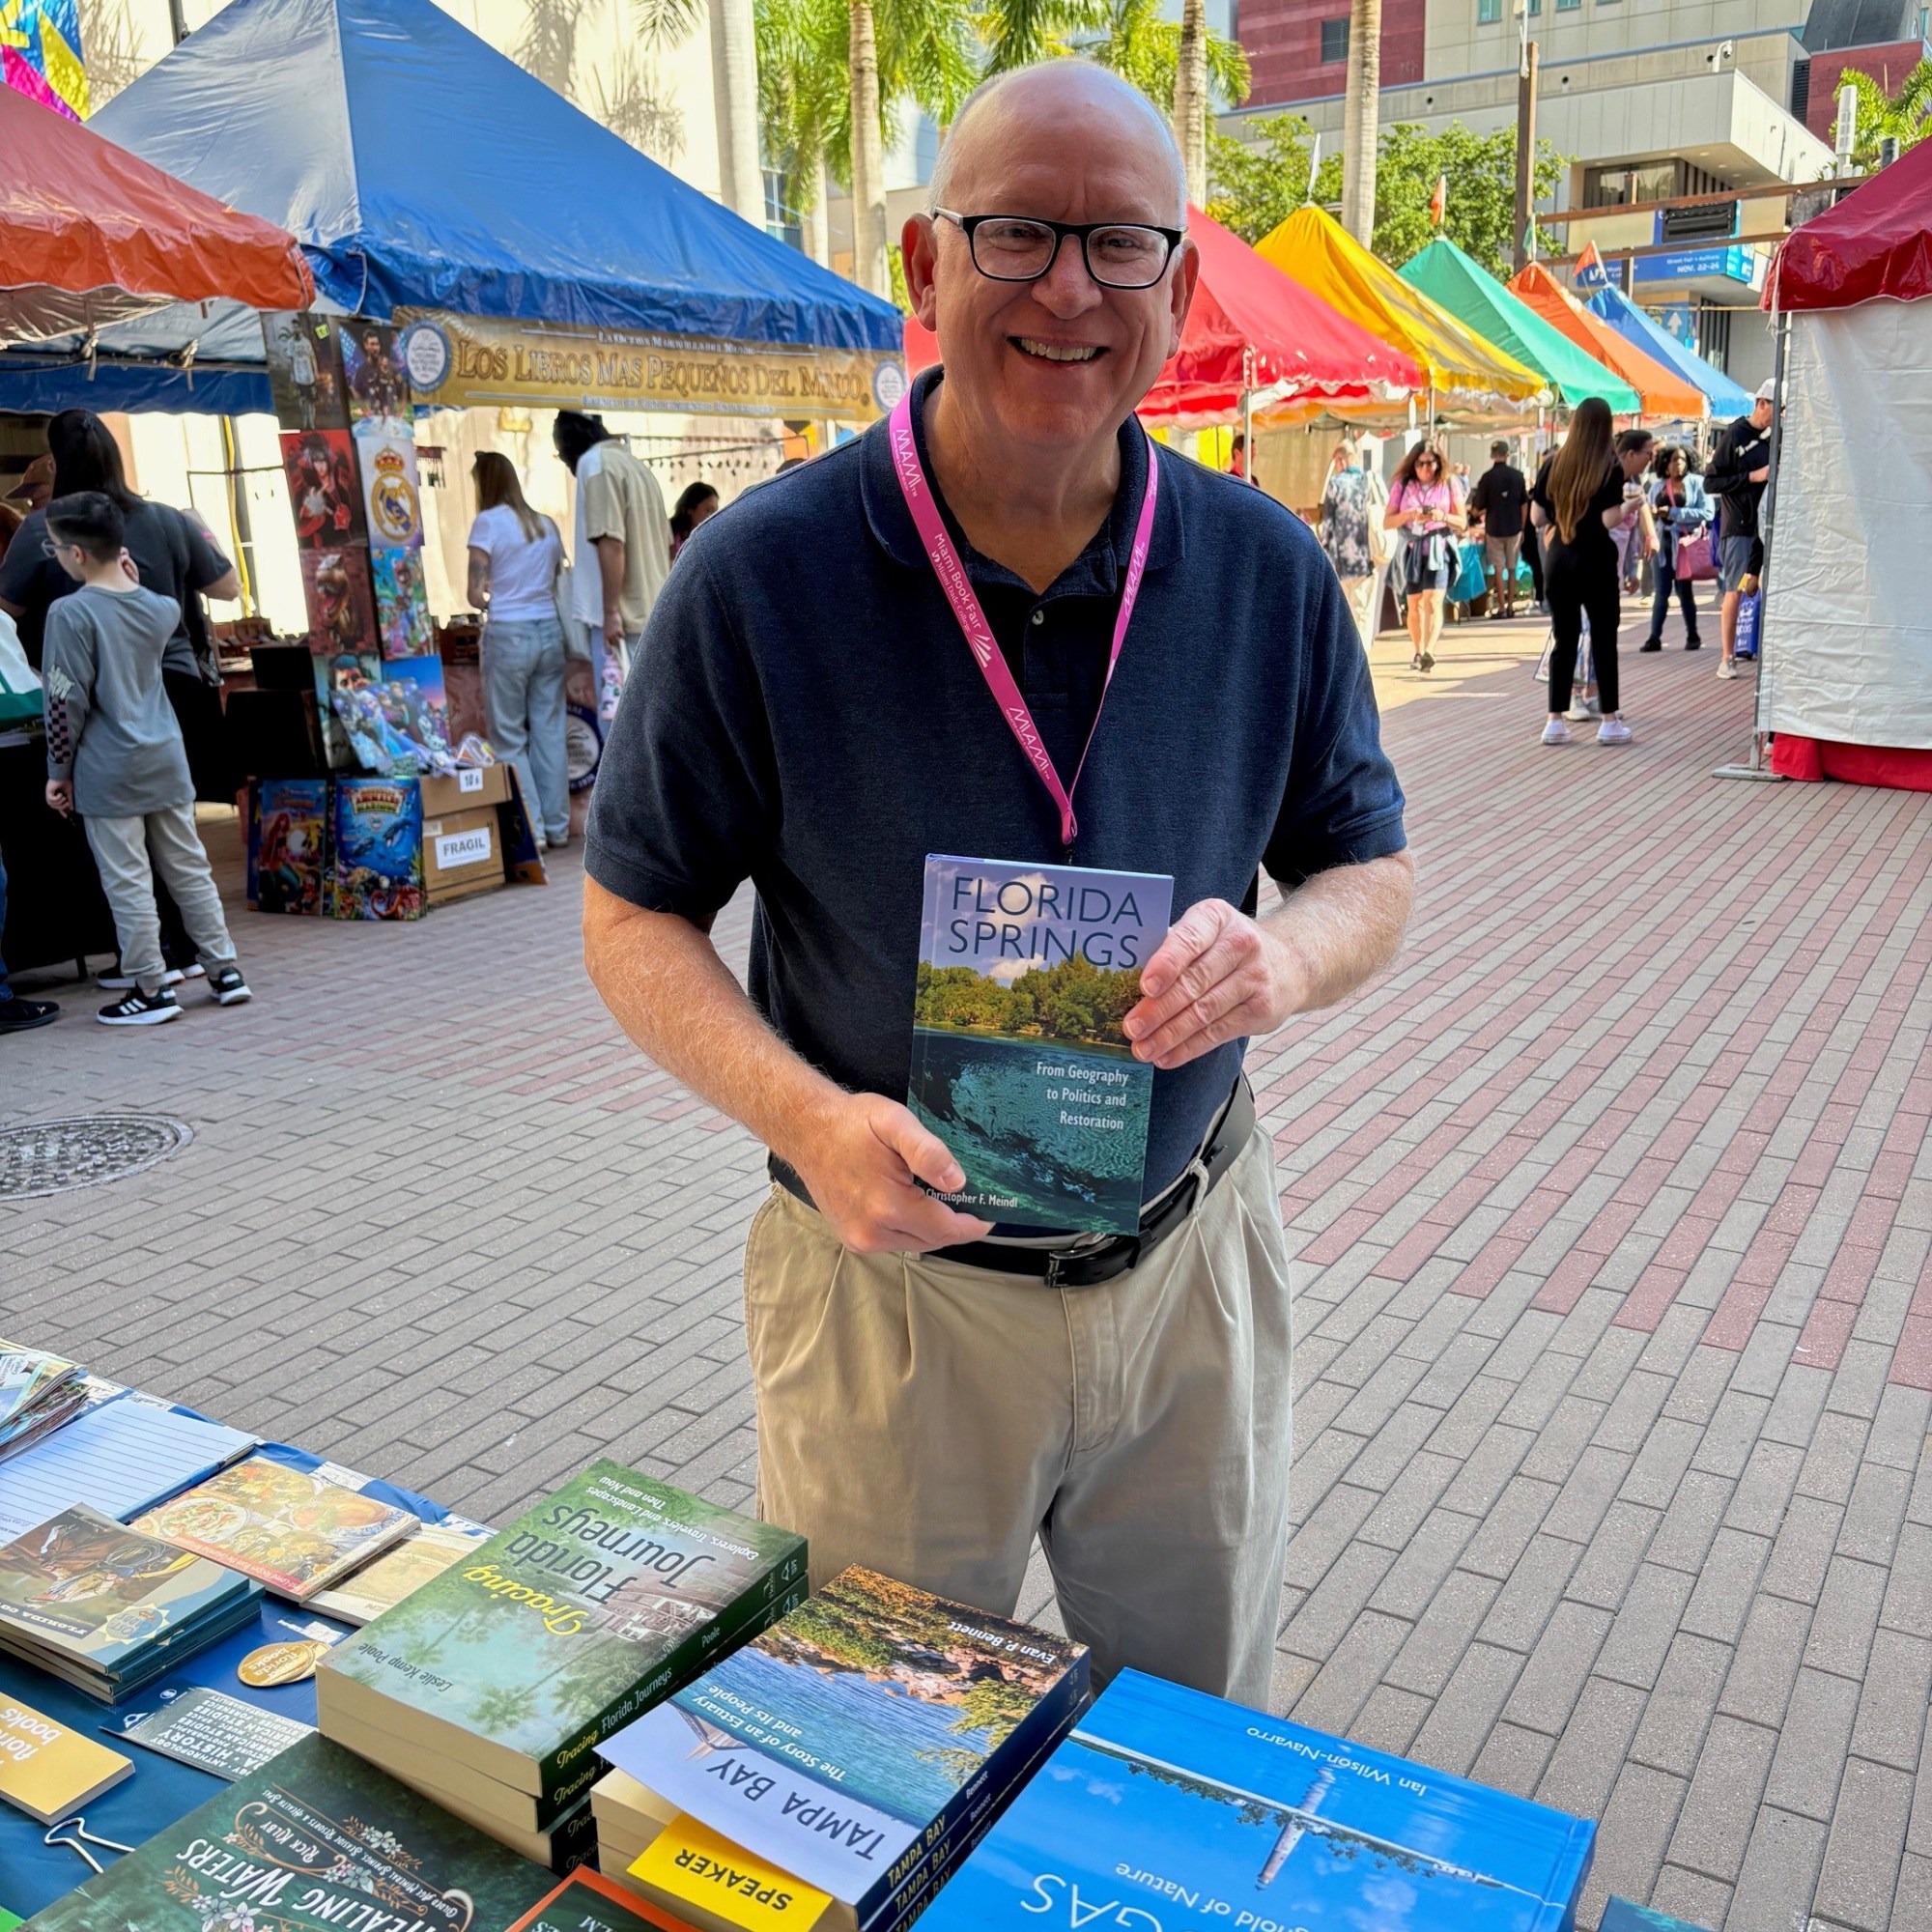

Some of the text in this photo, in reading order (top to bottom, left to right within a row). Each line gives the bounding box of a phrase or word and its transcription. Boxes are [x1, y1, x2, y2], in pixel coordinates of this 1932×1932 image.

[1677, 264, 1695, 273] NOV.
[458, 339, 509, 381] LOS
[514, 344, 593, 386] LIBROS
[596, 351, 643, 388] MAS
[648, 355, 751, 397] PEQUEÑOS
[753, 363, 795, 396] DEL
[895, 429, 921, 488] MIAMI
[934, 533, 982, 629] Miami Book Fair
[937, 562, 972, 632] Miami Dade College
[1009, 708, 1049, 770] MIAMI
[443, 838, 485, 857] FRAGIL
[952, 876, 1143, 926] FLORIDA
[949, 920, 1138, 969] SPRINGS
[1037, 1062, 1128, 1087] From Geography
[1047, 1089, 1126, 1107] to Politics and
[1060, 1111, 1123, 1130] Restoration
[926, 1188, 1018, 1208] Christopher F. Meindl
[600, 1477, 667, 1510] Then and Now
[586, 1486, 758, 1561] Explorers, Travelers, and Landscapes
[542, 1505, 717, 1588] Journeys
[504, 1531, 638, 1605] Florida
[463, 1565, 588, 1636] Tracing
[22, 1611, 88, 1635] FLORIDA
[948, 1620, 1057, 1664] Evan P. Bennett
[247, 1647, 290, 1670] books
[254, 1652, 298, 1677] florida
[358, 1643, 453, 1692] Leslie Kemp Poole
[193, 1704, 245, 1727] STUDIES
[202, 1699, 253, 1720] FORENSICS
[208, 1694, 269, 1719] SUSTAINABILITY
[556, 1729, 599, 1770] Tracing
[602, 1702, 632, 1734] Florida
[633, 1667, 672, 1710] Journeys
[701, 1627, 721, 1647] Poole
[708, 1685, 803, 1739] and Its People
[0, 1708, 63, 1746] books
[157, 1729, 233, 1761] HISTORY
[170, 1722, 231, 1750] PHOTOGRAPHY
[177, 1716, 225, 1741] STUDIES
[185, 1710, 282, 1748] DANCE MUSIC SPACE
[255, 1718, 295, 1736] STUDIES
[692, 1695, 846, 1781] The Story of an Estuary
[150, 1736, 228, 1769] ANTHROPOLOGY
[1246, 1727, 1427, 1797] Ian Wilson-Navarro
[262, 1789, 282, 1804] SPAS
[554, 1766, 597, 1805] Tracing
[277, 1800, 304, 1818] HEALTH
[706, 1758, 886, 1861] TAMPA BAY
[260, 1820, 320, 1863] RICK KILBY
[308, 1818, 336, 1839] RESORTS
[334, 1835, 363, 1858] SEASIDE
[887, 1771, 989, 1889] TAMPA BAY Bennett
[361, 1851, 392, 1876] SPRINGS,
[895, 1792, 992, 1914] TAMPA BAY Bennett
[932, 1866, 952, 1896] BAY
[970, 1821, 992, 1849] Bennett
[176, 1838, 296, 1907] WATERS
[388, 1872, 419, 1893] MINERAL
[674, 1848, 794, 1911] SPEAKER
[1115, 1861, 1232, 1915] of Nature
[413, 1888, 434, 1902] AGE
[432, 1896, 459, 1918] GILDED
